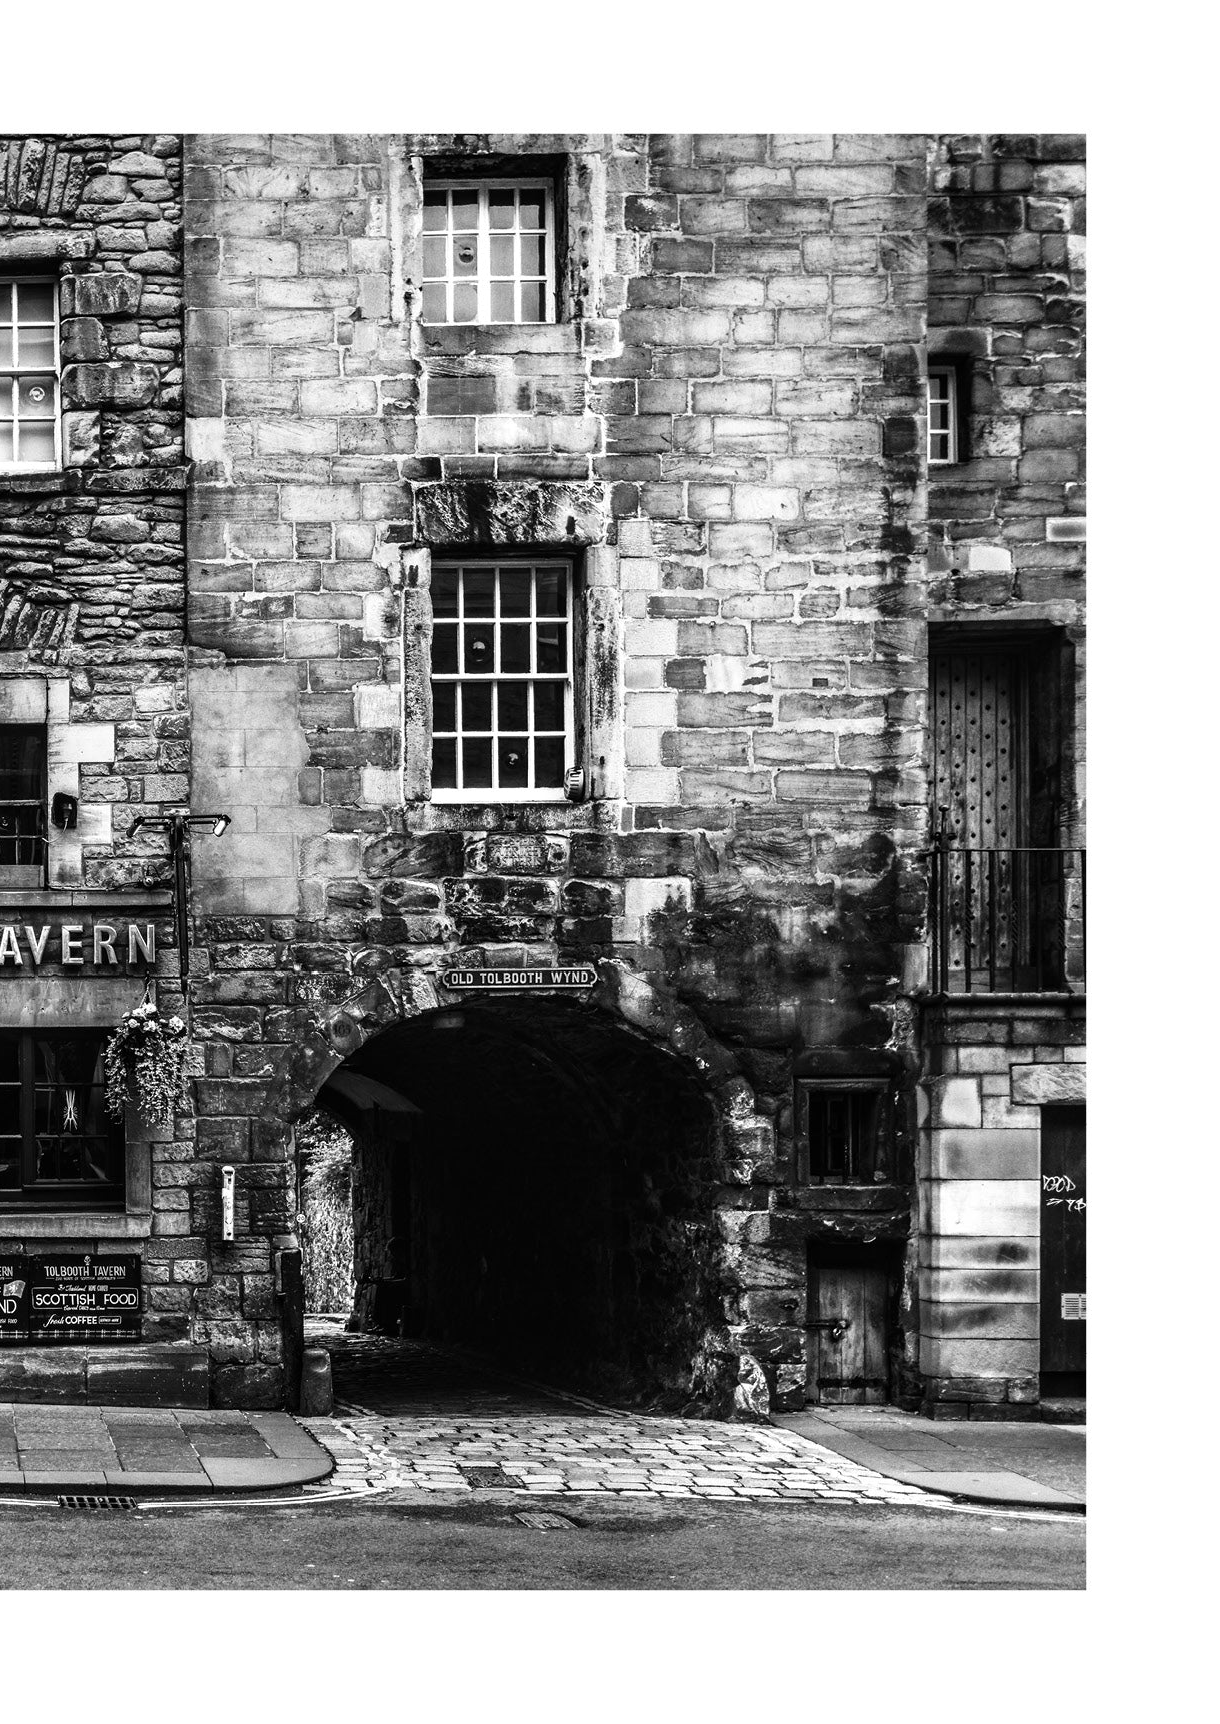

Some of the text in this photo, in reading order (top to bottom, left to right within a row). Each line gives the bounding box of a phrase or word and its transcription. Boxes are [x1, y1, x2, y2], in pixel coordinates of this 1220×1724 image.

[451, 971, 589, 985] OLD TOLBOOTH WYND
[43, 1265, 126, 1276] TOLBOOTH TAVERN
[35, 1293, 136, 1305] SCOTTISH FOOD
[65, 1316, 98, 1325] COFFEE
